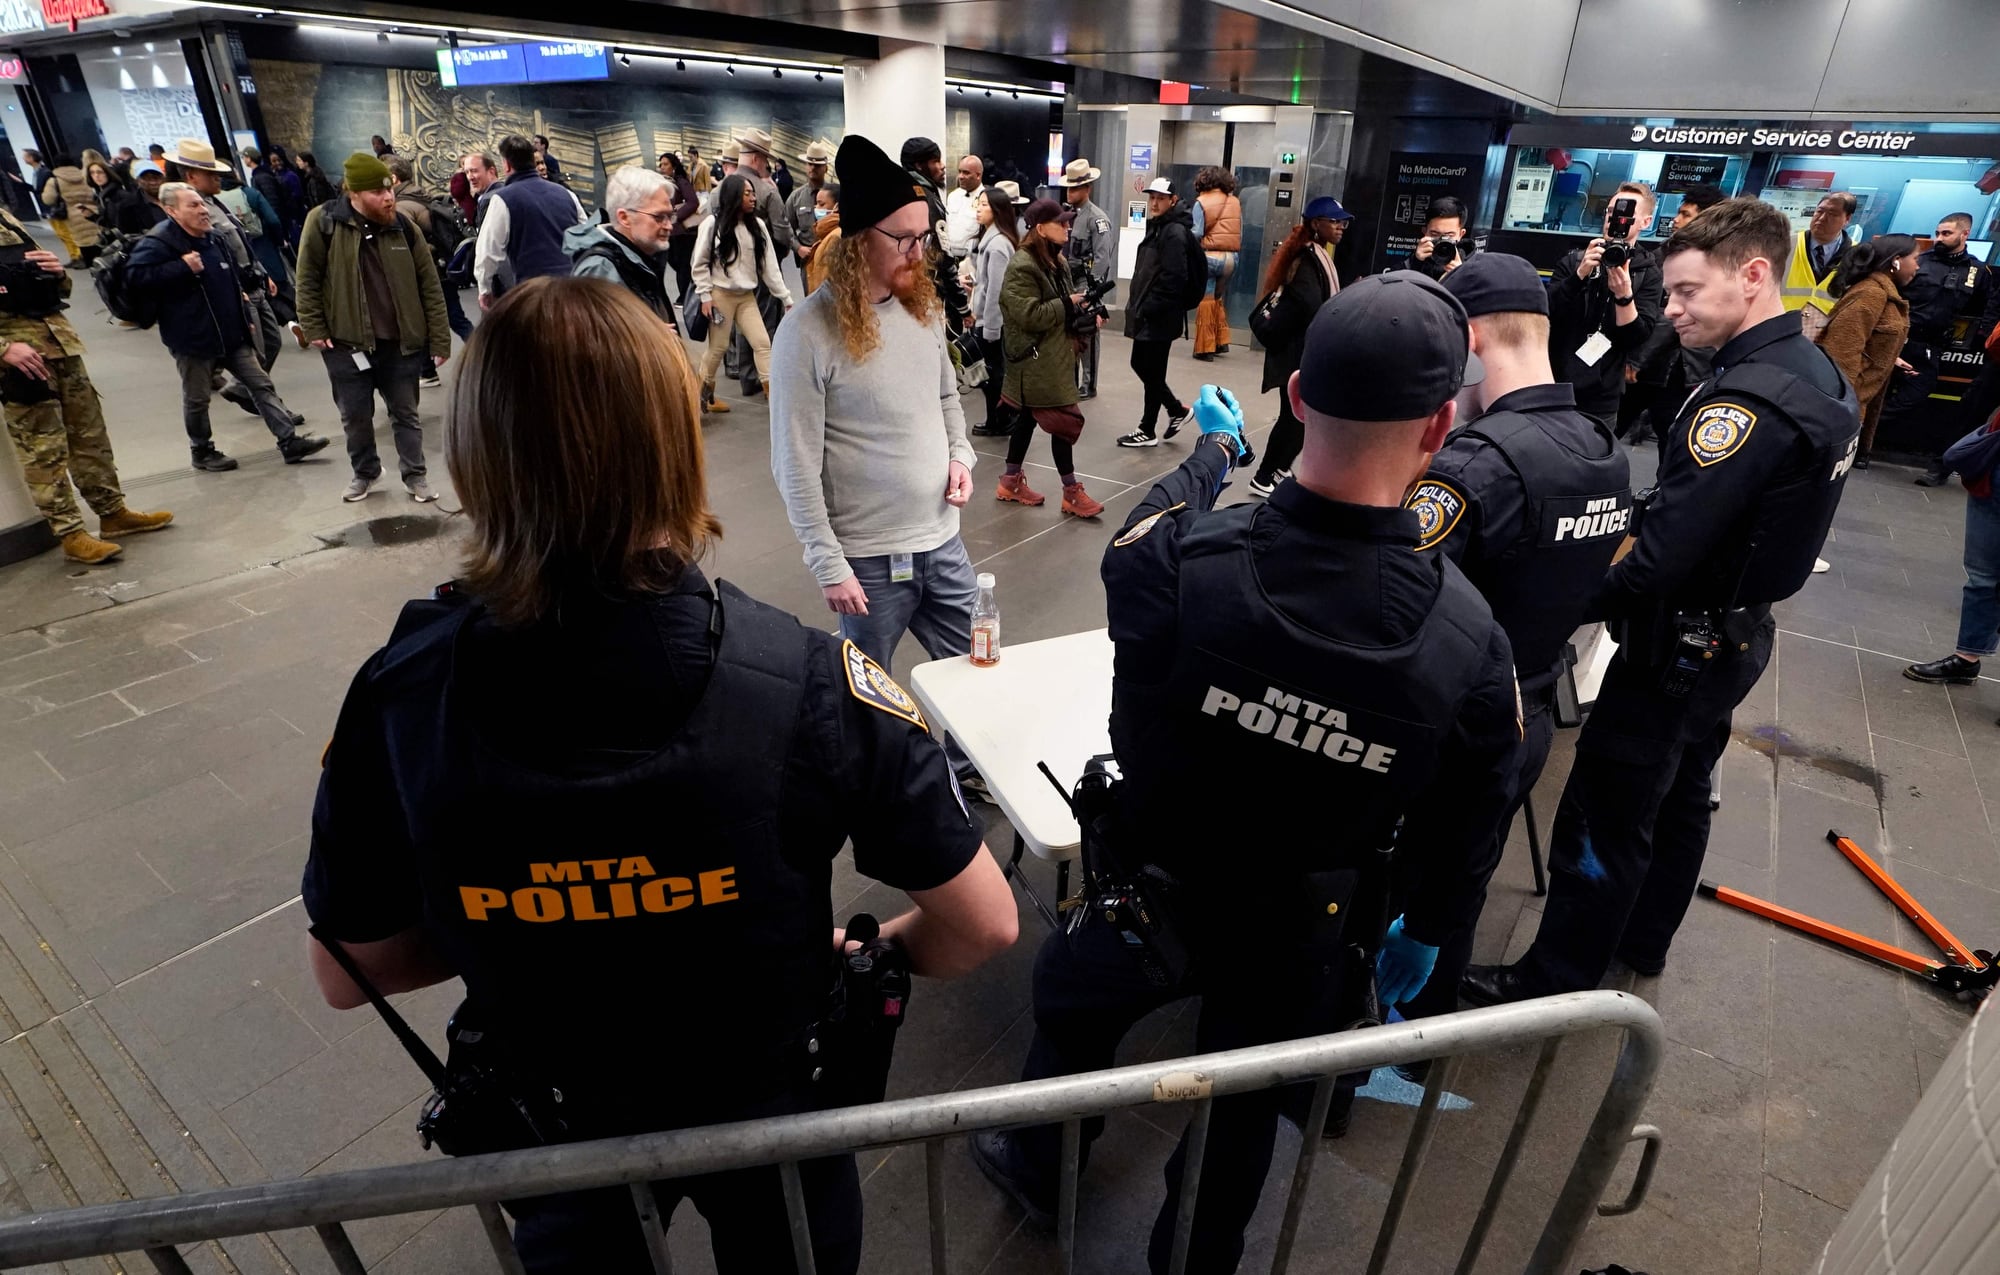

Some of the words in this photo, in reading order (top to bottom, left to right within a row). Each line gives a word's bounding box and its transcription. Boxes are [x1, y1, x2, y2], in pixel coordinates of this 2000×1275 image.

[1651, 126, 1748, 145] Customer
[1752, 128, 1831, 148] Service
[1838, 131, 1915, 150] Center
[1400, 165, 1412, 173] No
[1414, 165, 1466, 176] MetroCard?
[1668, 171, 1701, 181] Service
[1671, 163, 1714, 173] Customer
[1398, 175, 1410, 183] No
[1412, 176, 1448, 185] problem
[1940, 351, 1984, 365] ansit
[1699, 407, 1749, 429] POLICE
[1414, 486, 1459, 517] POLICE
[1586, 497, 1617, 514] MTA
[1554, 508, 1629, 541] POLICE
[1263, 686, 1347, 731] MTA
[1201, 685, 1397, 773] POLICE
[529, 856, 656, 883] MTA
[459, 866, 739, 923] POLICE
